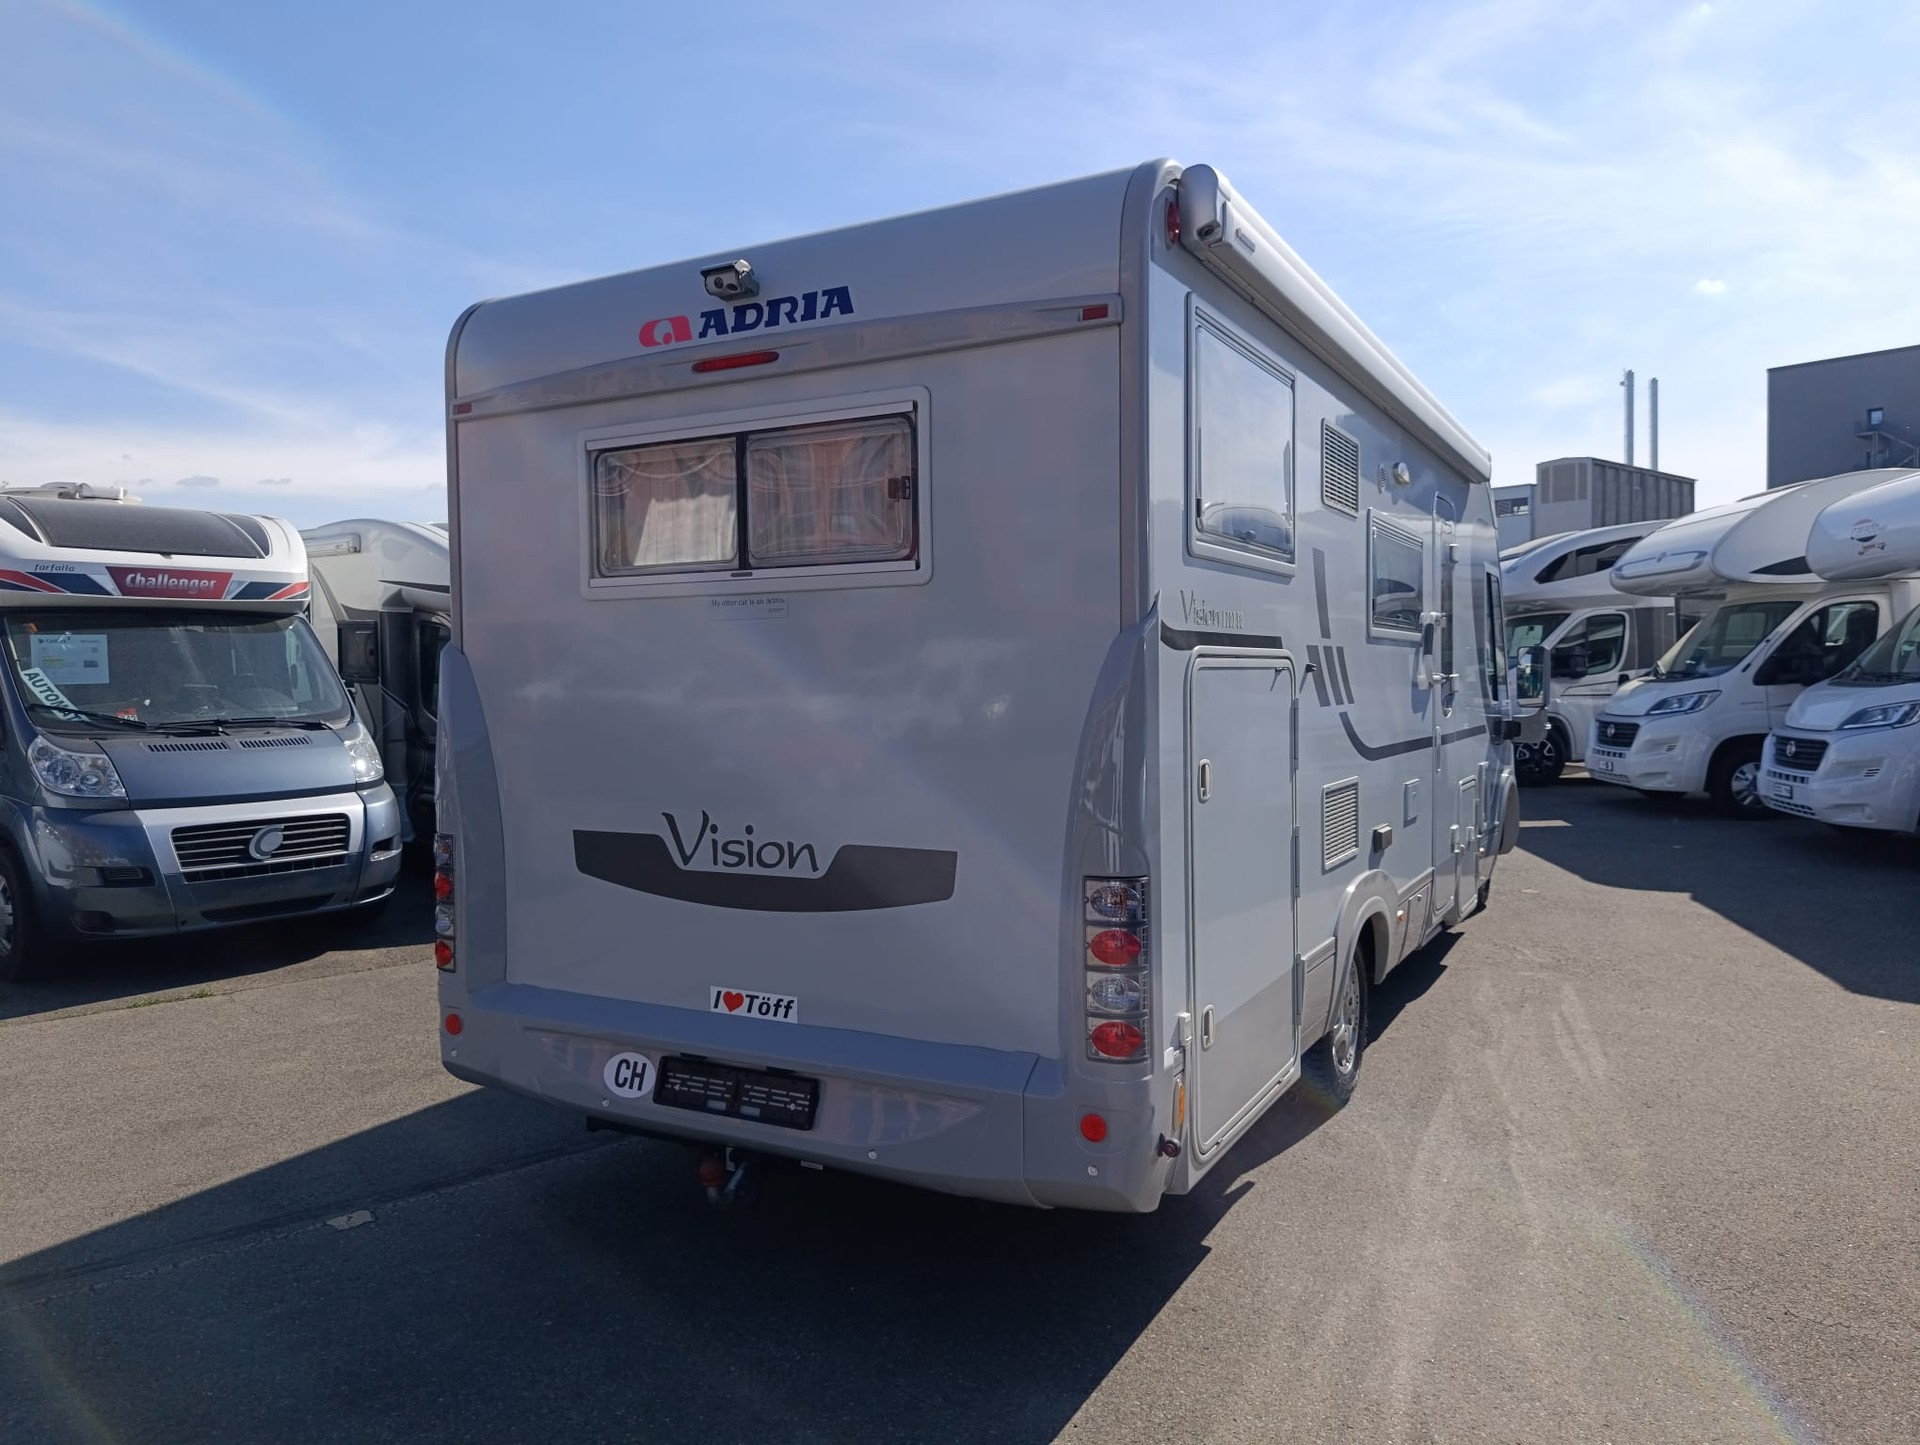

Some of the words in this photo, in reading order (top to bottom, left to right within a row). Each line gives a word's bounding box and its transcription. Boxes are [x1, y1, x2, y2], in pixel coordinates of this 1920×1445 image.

[698, 285, 855, 339] ADRIA
[125, 572, 217, 594] Challenger
[1179, 588, 1220, 628] Vision
[660, 809, 820, 873] Vision
[713, 990, 723, 1010] I
[745, 994, 795, 1019] Töff
[614, 1058, 648, 1092] CH
